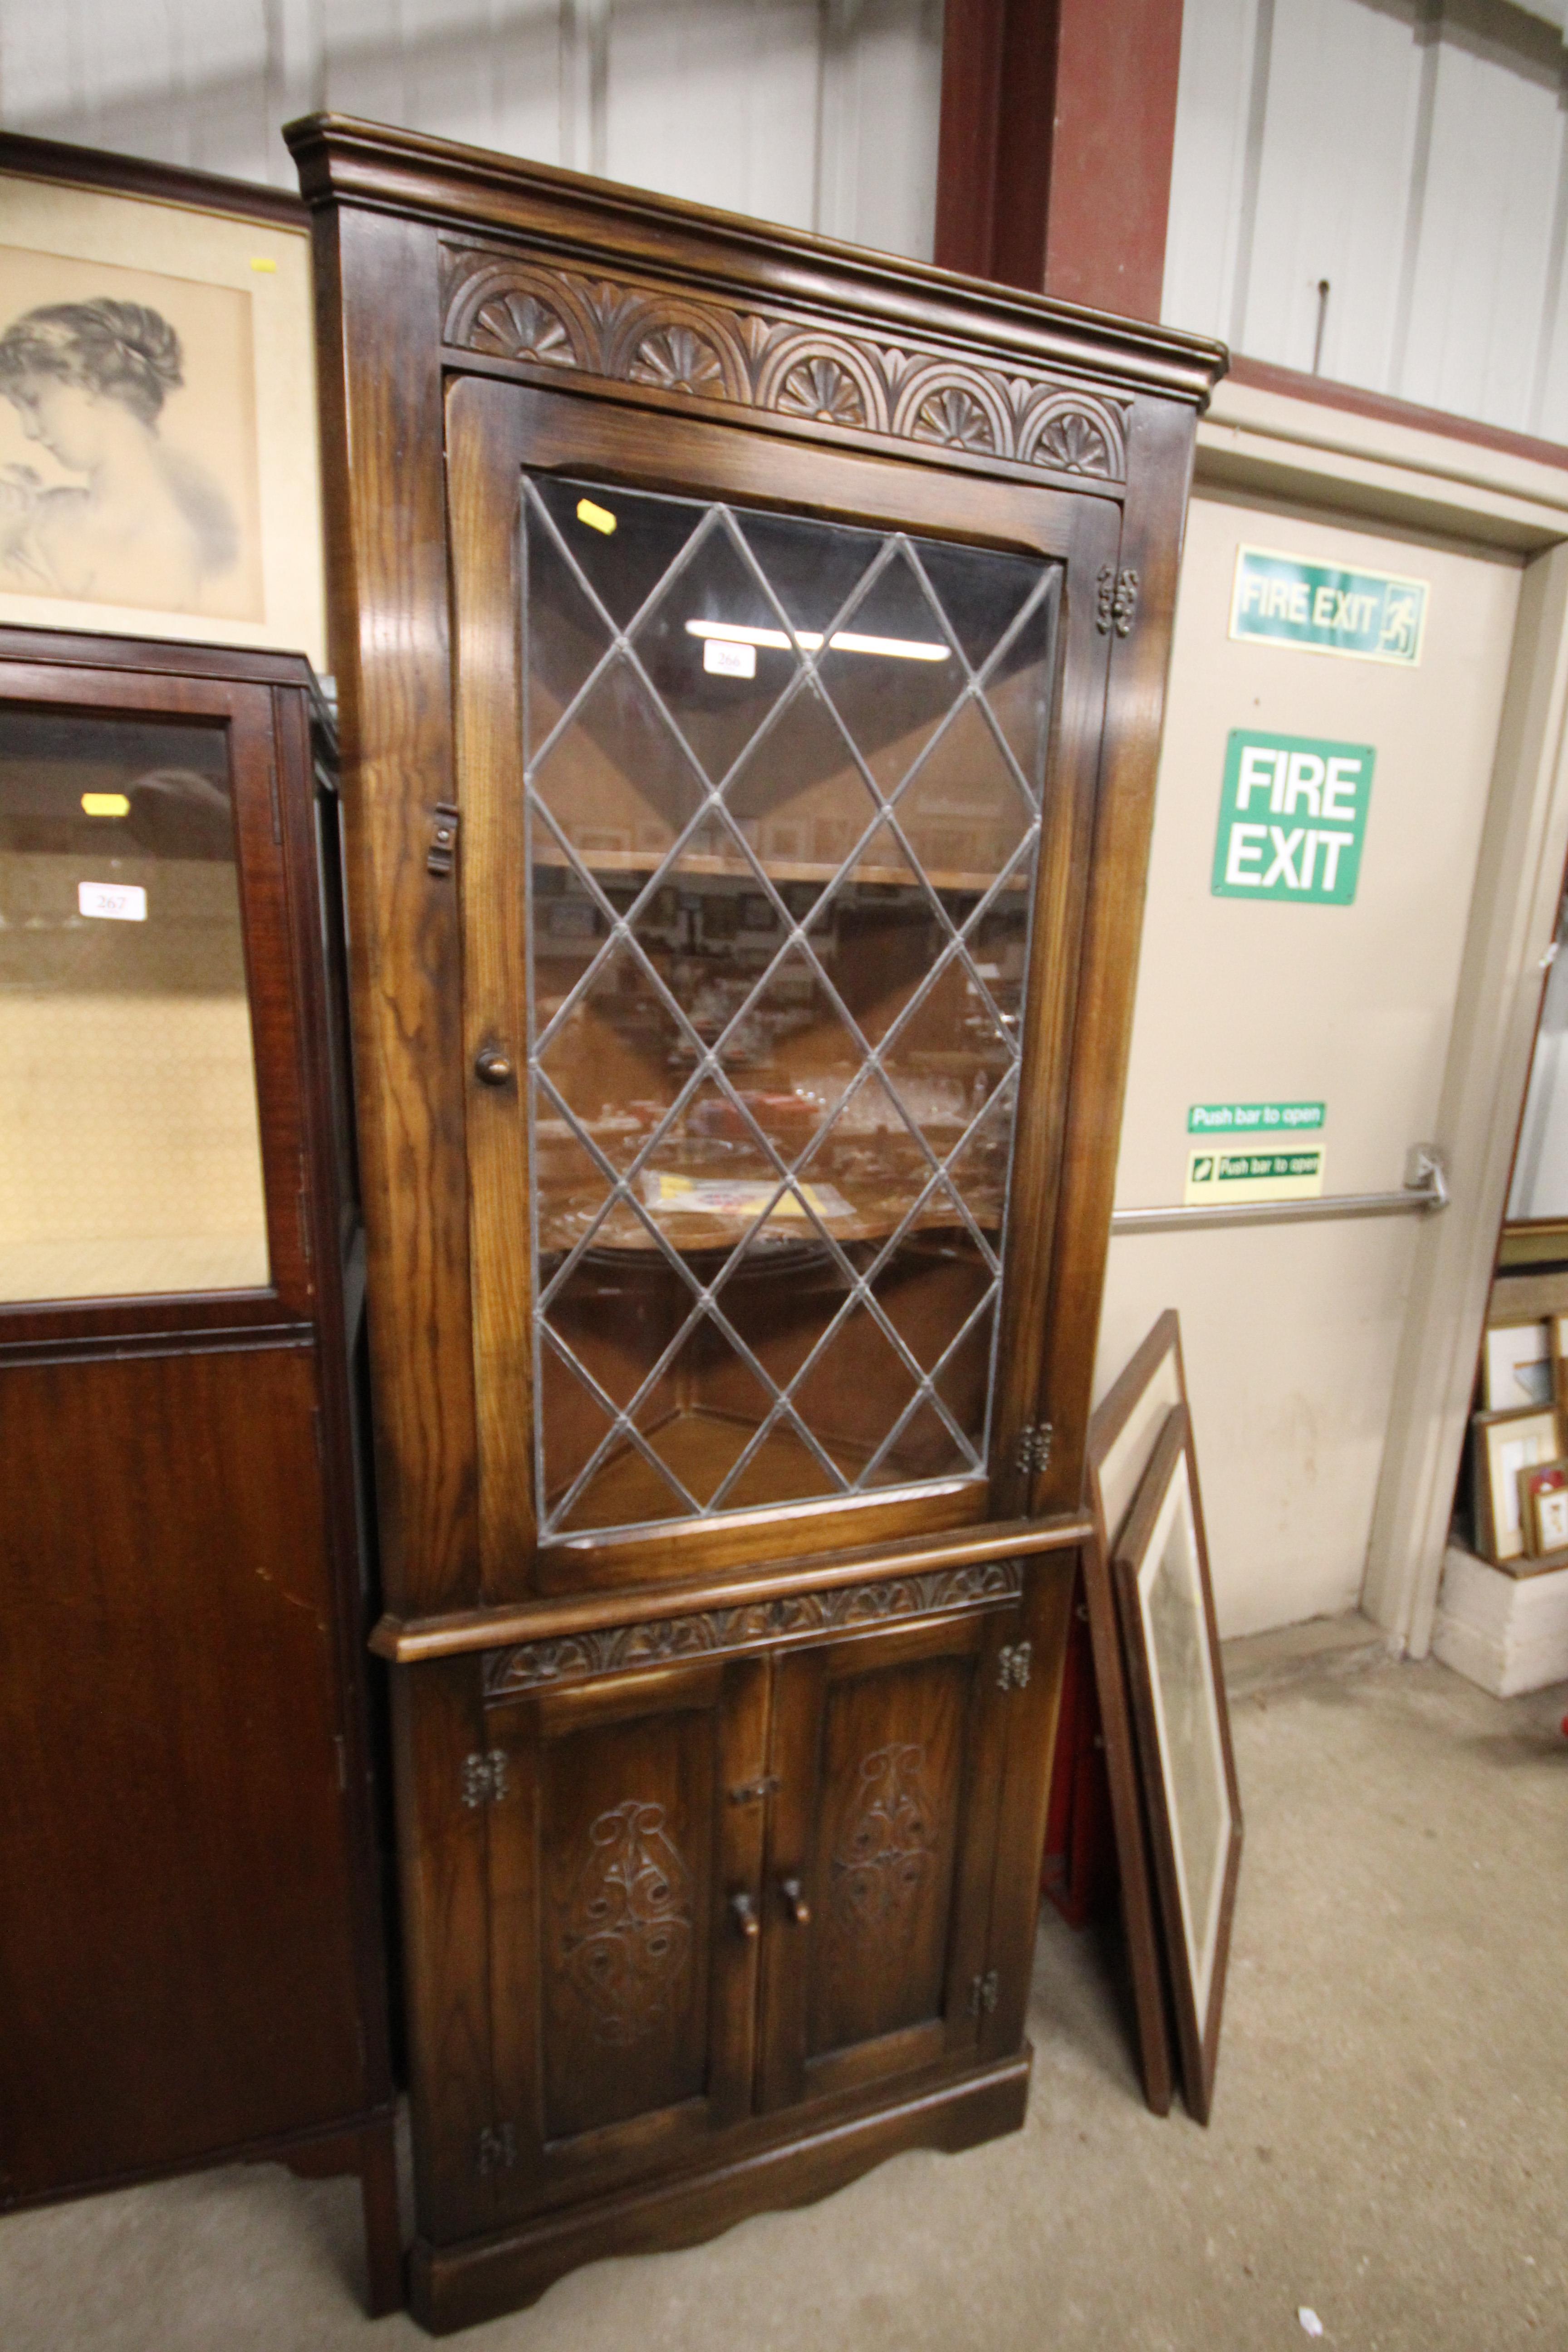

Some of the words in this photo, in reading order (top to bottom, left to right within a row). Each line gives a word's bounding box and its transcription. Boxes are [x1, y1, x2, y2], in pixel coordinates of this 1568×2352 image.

[1241, 574, 1310, 623] FIRE
[1313, 586, 1377, 634] EXIT
[1236, 746, 1361, 821] FIRE
[1225, 823, 1353, 891] EXIT
[96, 895, 127, 909] 267
[1193, 1107, 1232, 1126] Push
[1235, 1107, 1261, 1125] bar
[1264, 1107, 1280, 1124] to
[1283, 1107, 1320, 1126] open
[1220, 1158, 1249, 1175] Push
[1252, 1158, 1272, 1174] bar
[1275, 1157, 1288, 1172] to
